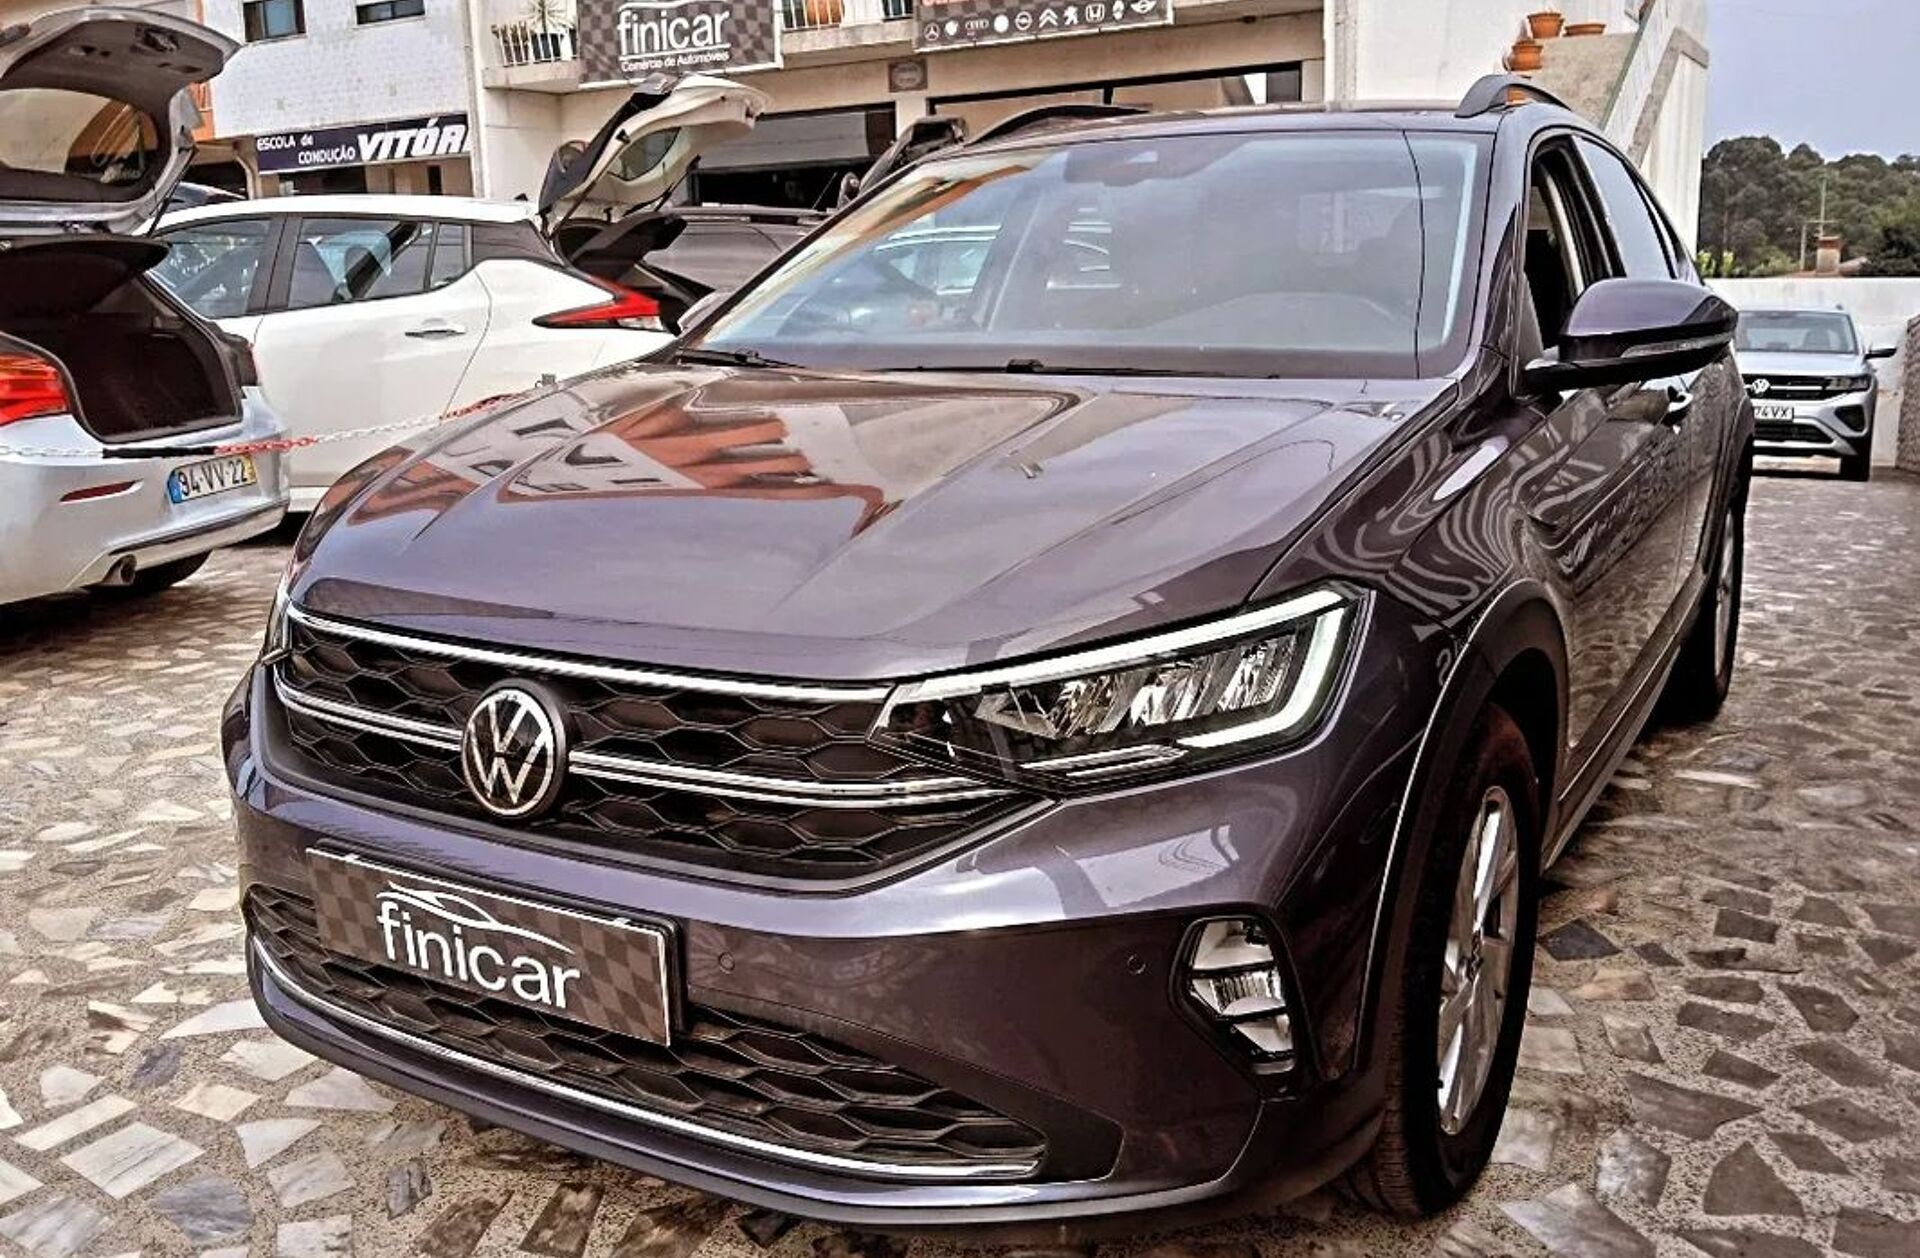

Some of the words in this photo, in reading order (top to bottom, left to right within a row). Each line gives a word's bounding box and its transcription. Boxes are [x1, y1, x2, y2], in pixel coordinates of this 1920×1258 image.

[617, 10, 730, 55] finicar
[621, 58, 663, 72] Comércio
[664, 56, 676, 68] de
[677, 51, 730, 66] Automóveis
[256, 135, 296, 151] ESCOLA
[298, 145, 356, 164] CONDUÇÃO
[376, 901, 581, 1009] finicar
